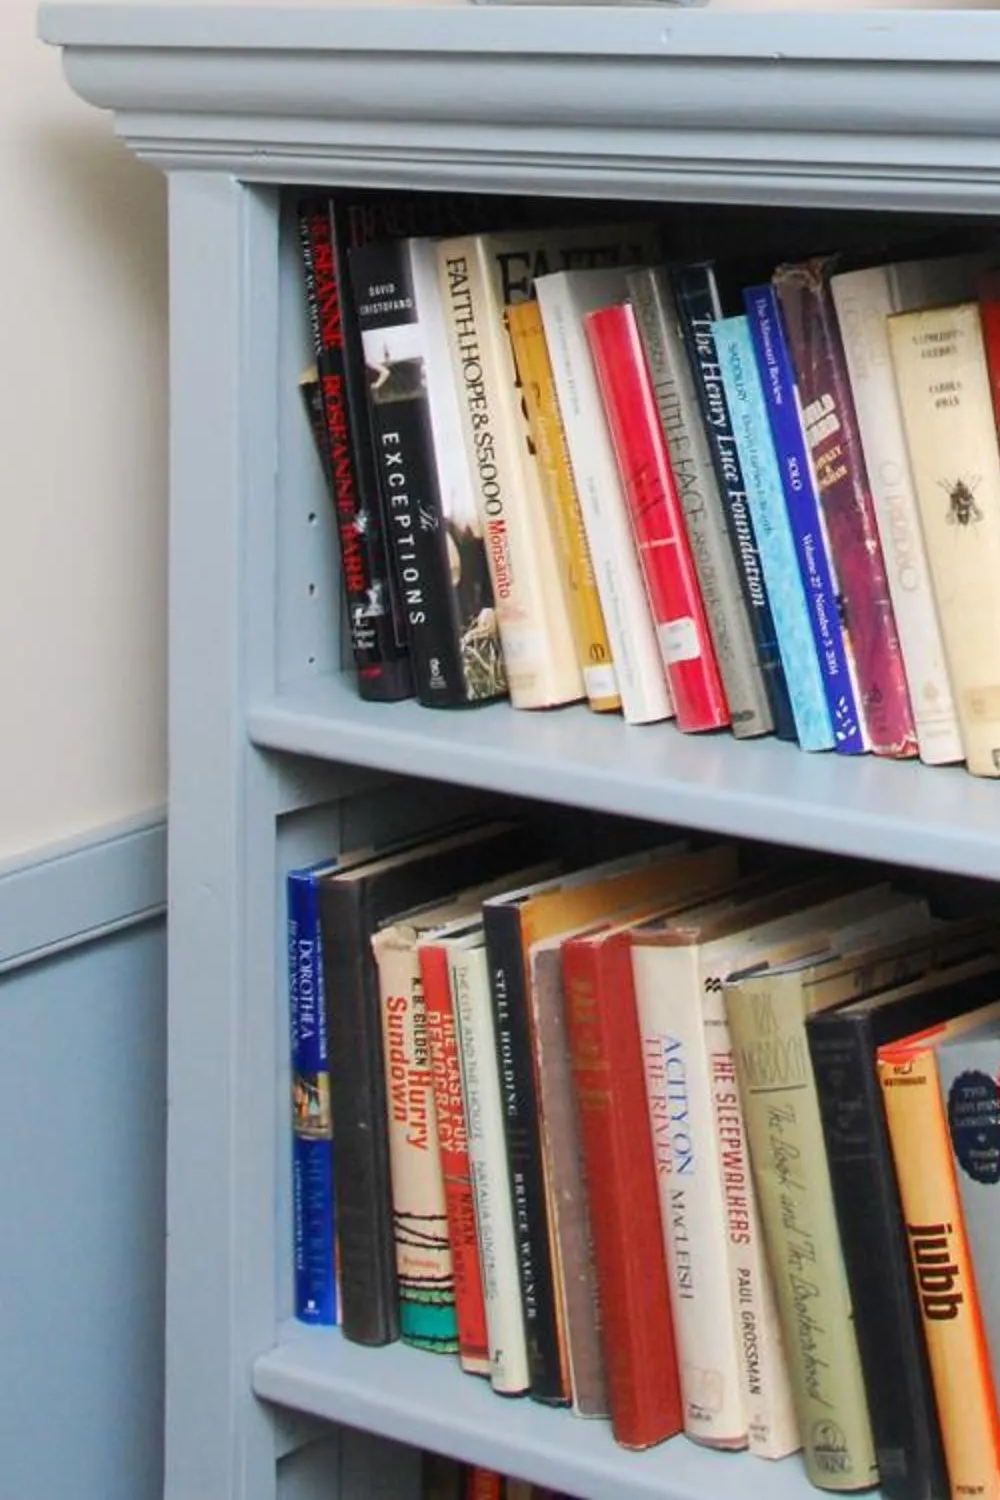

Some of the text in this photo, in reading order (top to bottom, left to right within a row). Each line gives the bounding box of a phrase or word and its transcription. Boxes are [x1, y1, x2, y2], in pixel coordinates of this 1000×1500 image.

[368, 283, 396, 297] DAVID
[461, 345, 487, 411] HOPE
[755, 298, 783, 405] The Missouri Review
[321, 374, 357, 513] ROSEANNE
[342, 524, 365, 591] BARR
[674, 457, 705, 518] FACE
[691, 311, 764, 607] The Henry Luce Foundation
[788, 457, 802, 491] SOLO
[382, 432, 425, 624] EXCEPTIONS
[488, 519, 510, 599] Monsanto
[802, 533, 818, 574] Volume
[815, 592, 833, 635] Number
[298, 939, 315, 1041] DOROTHEA
[412, 1013, 429, 1067] GILDEN
[441, 1009, 457, 1045] THE
[387, 996, 411, 1122] Sundown
[446, 1052, 465, 1104] CASE
[495, 967, 519, 1117] STILL HOLDING
[711, 1052, 735, 1084] THE
[408, 1070, 432, 1151] Hurry
[642, 1035, 674, 1176] THE RIVER
[664, 1034, 695, 1177] A CITY ON
[766, 1102, 798, 1135] The
[769, 1136, 806, 1192] Book
[514, 1172, 537, 1319] BRUCE WAGNER
[669, 1188, 695, 1300] MACLEISH
[779, 1193, 809, 1238] and
[786, 1233, 818, 1272] The
[908, 1222, 964, 1323] jubb
[737, 1268, 762, 1396] PAUL GROSSMAN
[787, 1273, 835, 1410] Brotherhood
